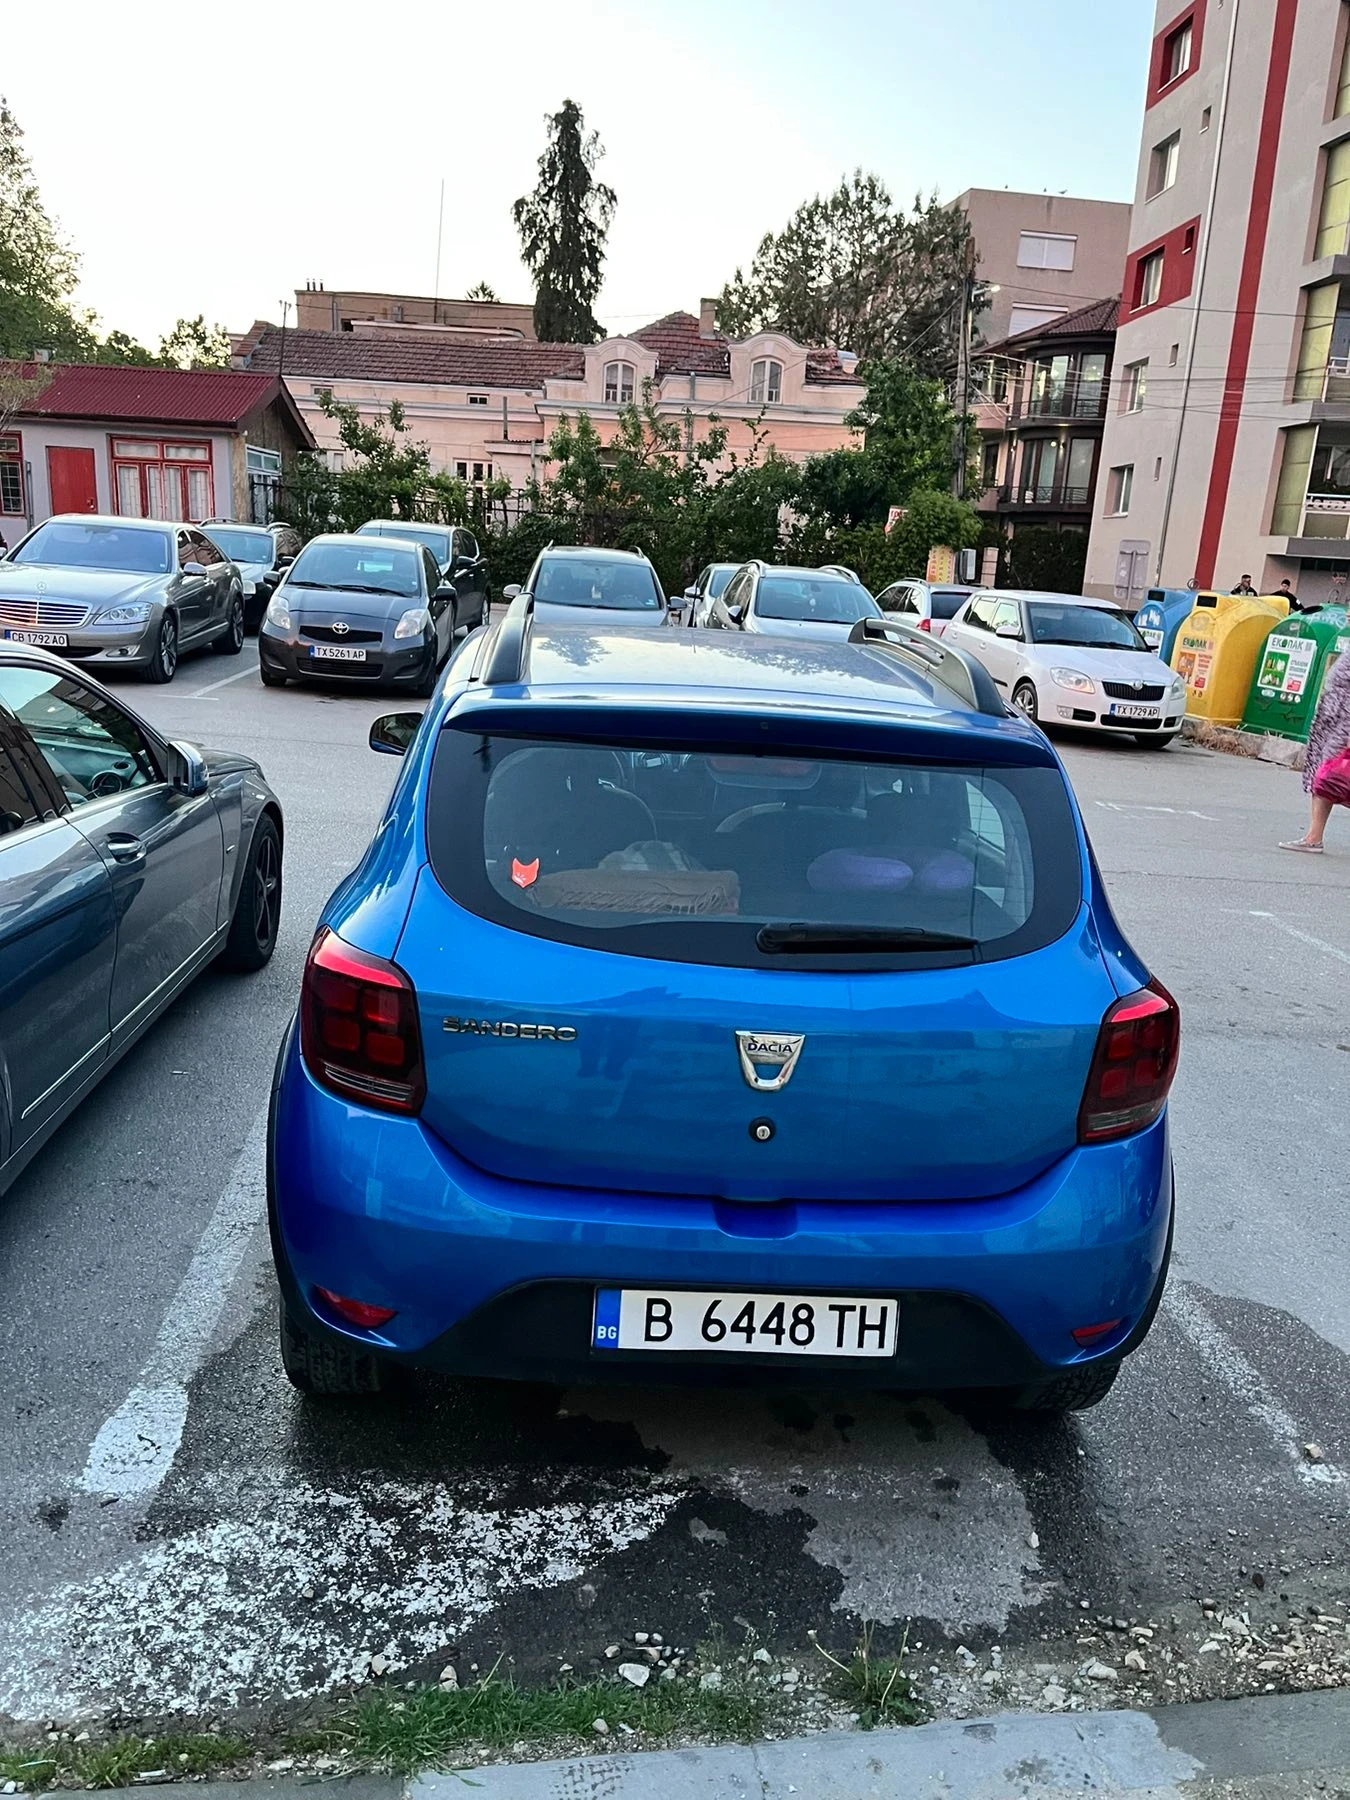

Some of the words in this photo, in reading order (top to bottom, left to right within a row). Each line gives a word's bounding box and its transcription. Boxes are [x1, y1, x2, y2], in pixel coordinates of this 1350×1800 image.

[27, 633, 50, 645] 1792
[1271, 637, 1304, 650] ЕКОПАК
[329, 648, 351, 659] 5261
[1129, 706, 1148, 717] 1729
[442, 1016, 577, 1041] SANDERO
[747, 1042, 793, 1053] DACIA
[644, 1297, 673, 1343] B
[700, 1299, 816, 1347] 6448
[828, 1304, 889, 1350] TH
[596, 1325, 618, 1340] BG
